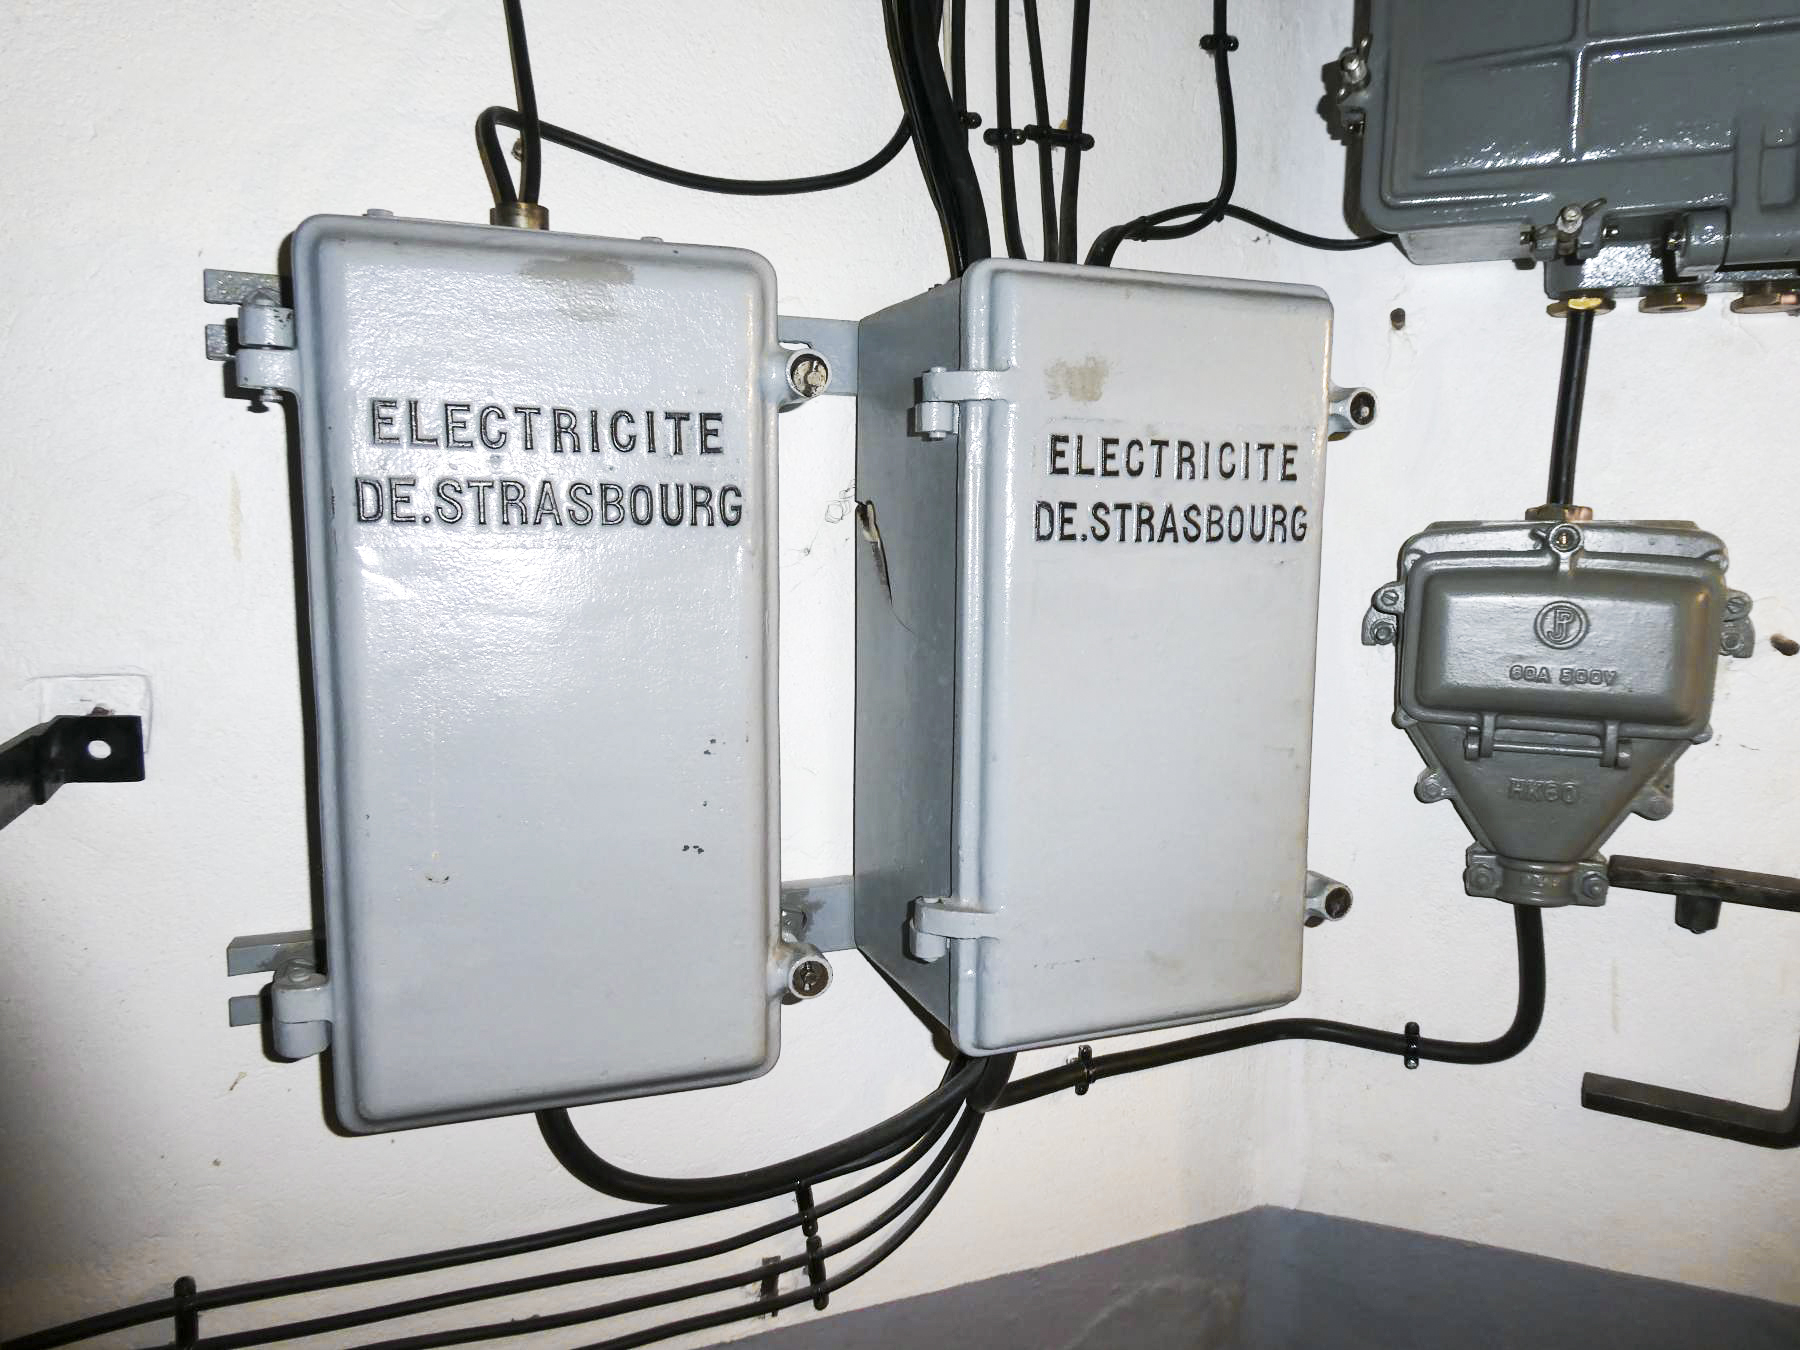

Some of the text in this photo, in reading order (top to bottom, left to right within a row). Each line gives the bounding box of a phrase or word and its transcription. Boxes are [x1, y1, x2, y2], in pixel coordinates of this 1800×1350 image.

[372, 399, 723, 455] ELECTRICITE
[1049, 434, 1298, 481] ELECTRICITE
[1559, 668, 1617, 687] 500V
